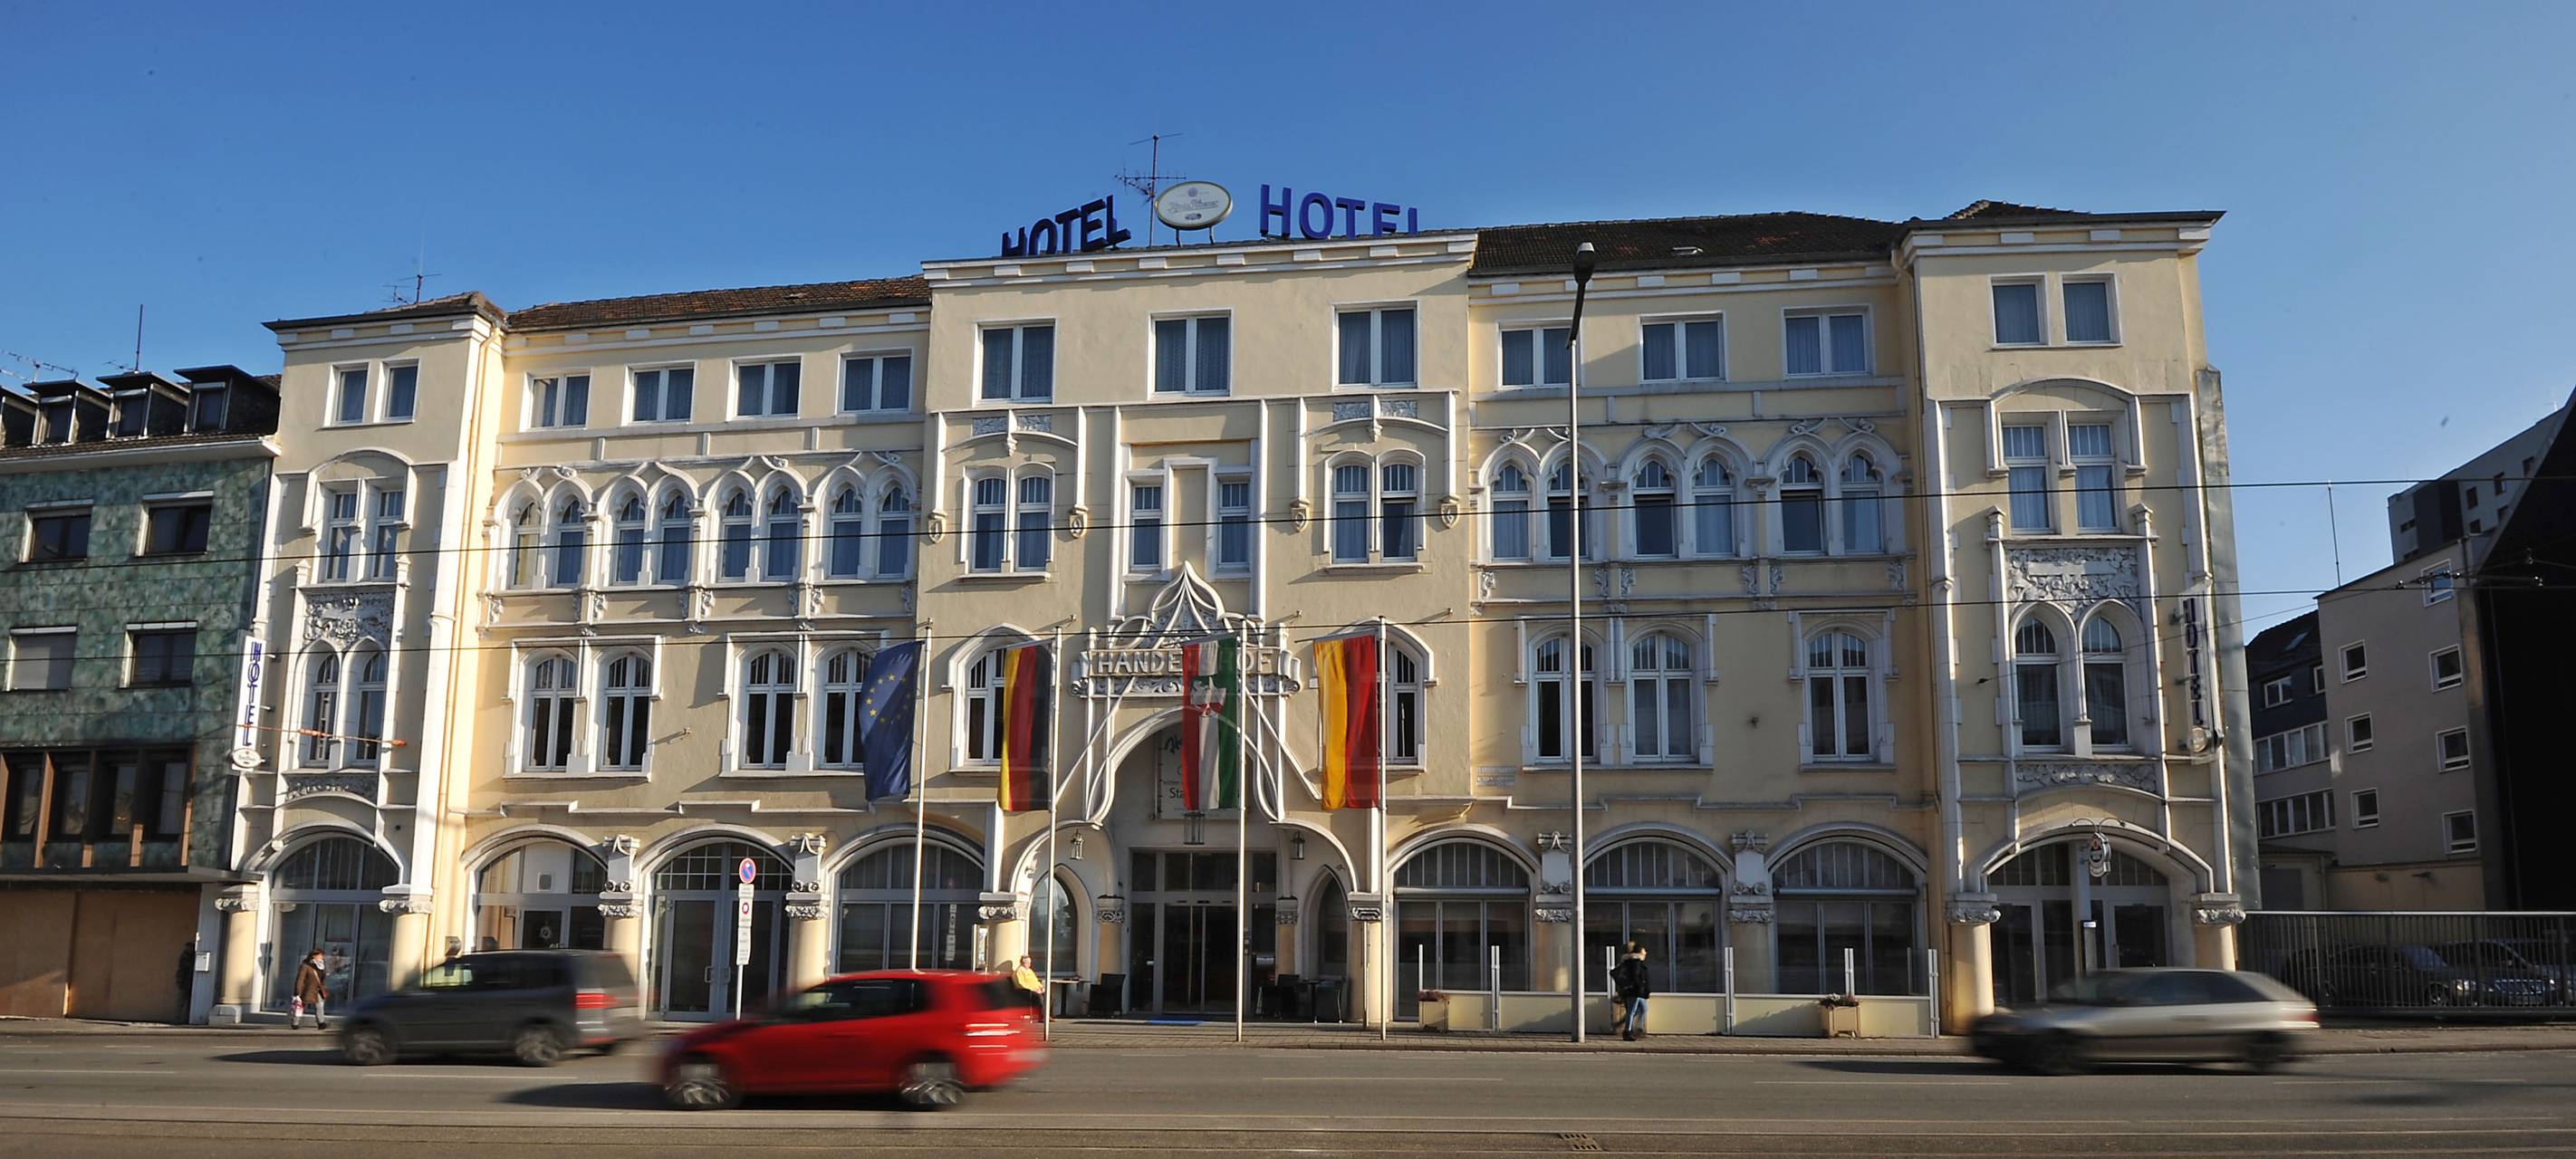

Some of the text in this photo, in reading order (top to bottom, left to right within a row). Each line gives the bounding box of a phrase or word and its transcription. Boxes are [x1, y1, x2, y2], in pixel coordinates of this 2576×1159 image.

[1002, 195, 1131, 257] HOTEL
[242, 641, 263, 746] HOTEL
[1098, 649, 1273, 674] HANDEOF
[2183, 598, 2204, 725] HOTEL
